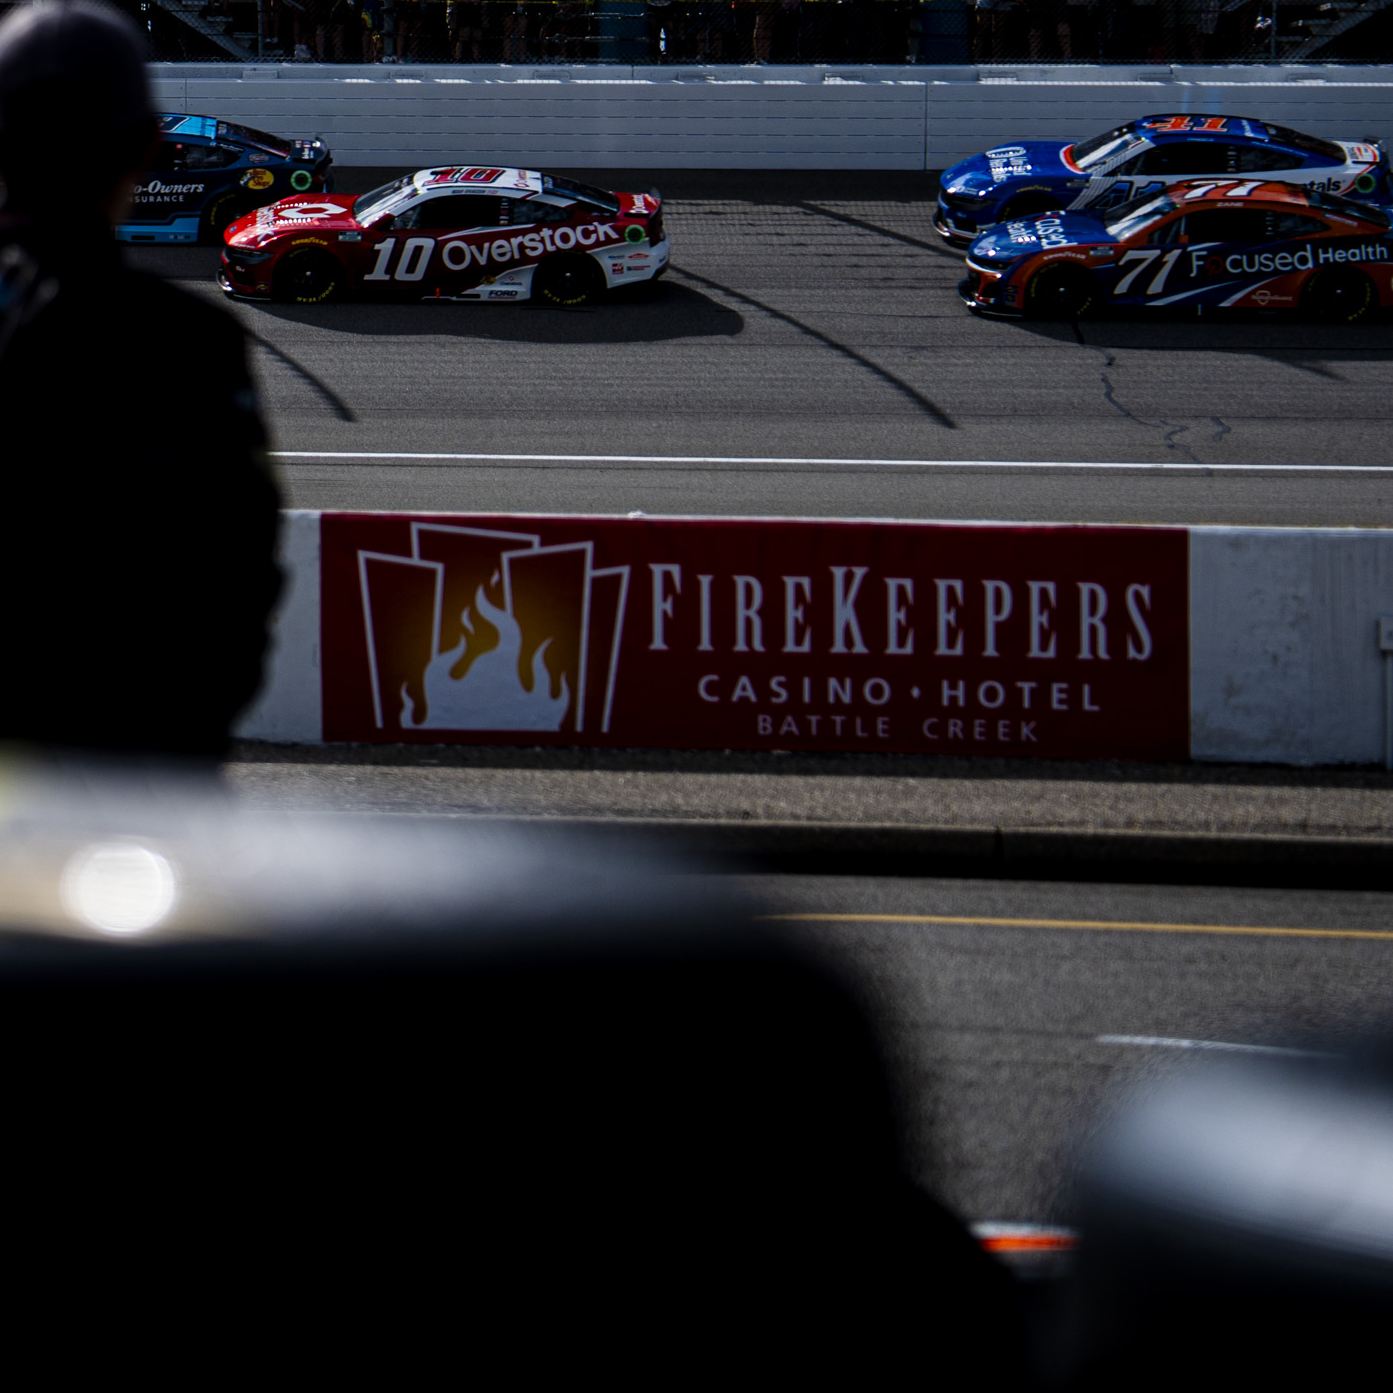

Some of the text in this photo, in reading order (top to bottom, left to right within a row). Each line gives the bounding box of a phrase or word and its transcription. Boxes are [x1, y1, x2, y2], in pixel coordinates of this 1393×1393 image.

[131, 179, 206, 195] o-Owners
[421, 167, 507, 186] 10
[1182, 180, 1267, 200] 71
[362, 235, 437, 282] 10
[441, 221, 620, 271] Overstock
[1188, 242, 1389, 278] Focused Health
[1112, 248, 1185, 296] 71
[696, 672, 1102, 713] CASINO HOTEL
[755, 713, 1039, 744] BATTLE CREEK
